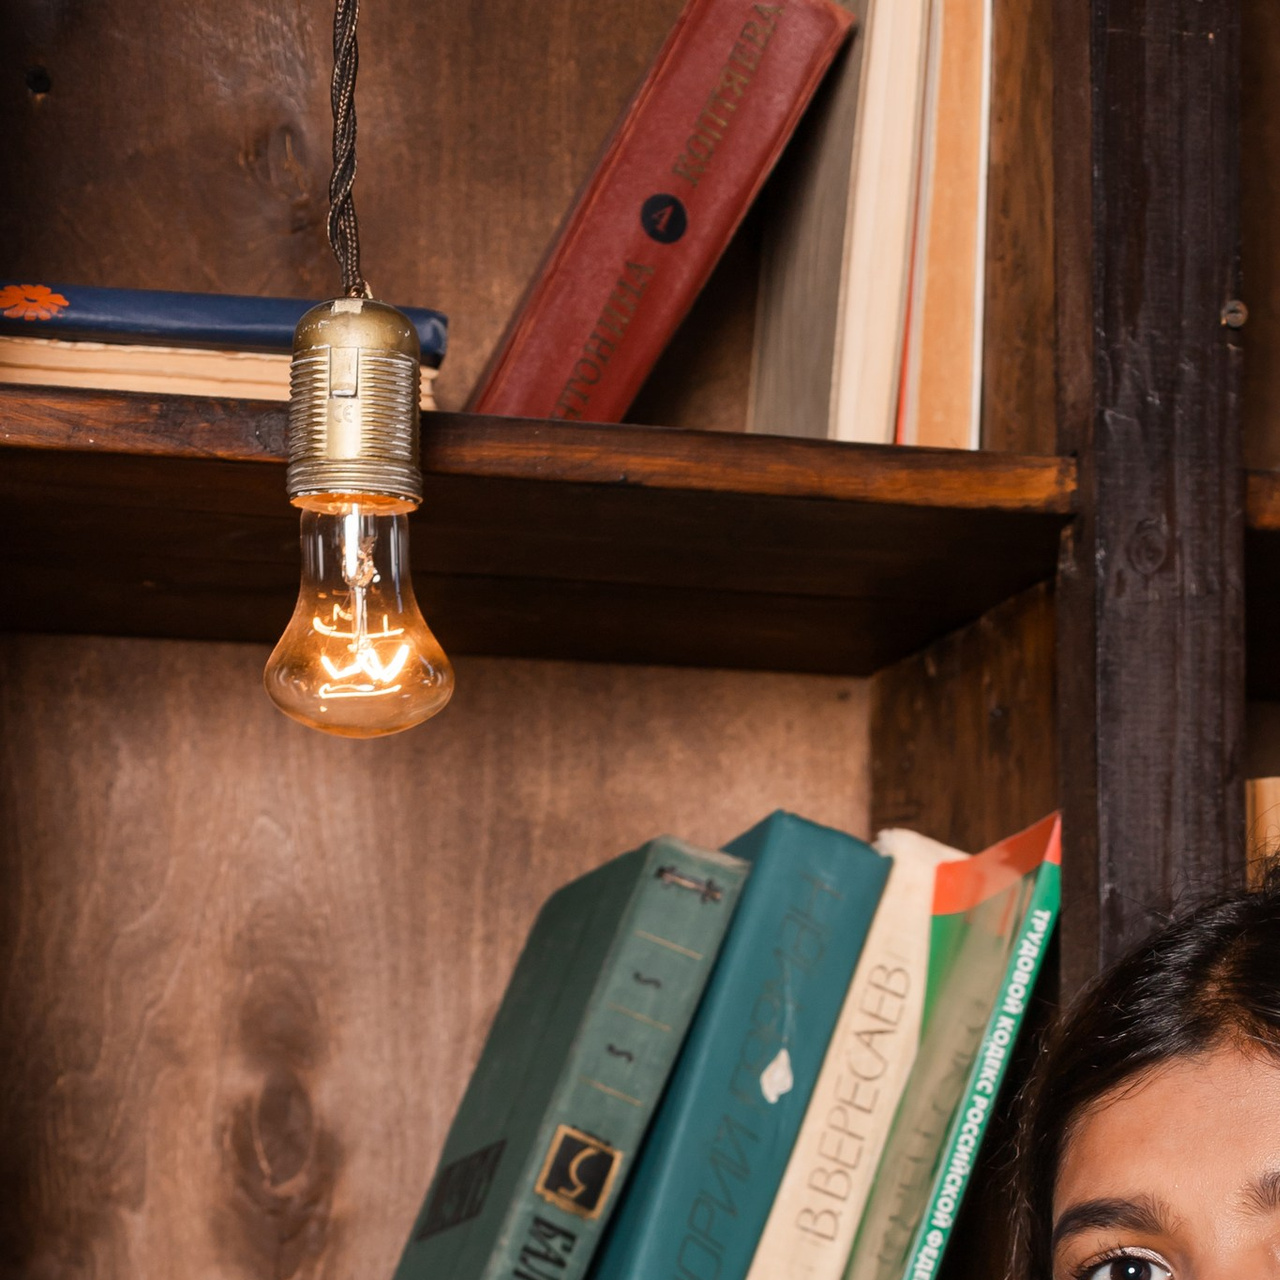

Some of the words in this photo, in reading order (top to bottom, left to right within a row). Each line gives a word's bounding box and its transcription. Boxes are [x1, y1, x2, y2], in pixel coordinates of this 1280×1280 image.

[552, 260, 656, 421] НТОНИНА
[998, 908, 1051, 1013] ТРУДОВОЙ
[975, 1014, 1018, 1098] КОДЕКС
[931, 1097, 990, 1227] РОССИЙСКОЙ
